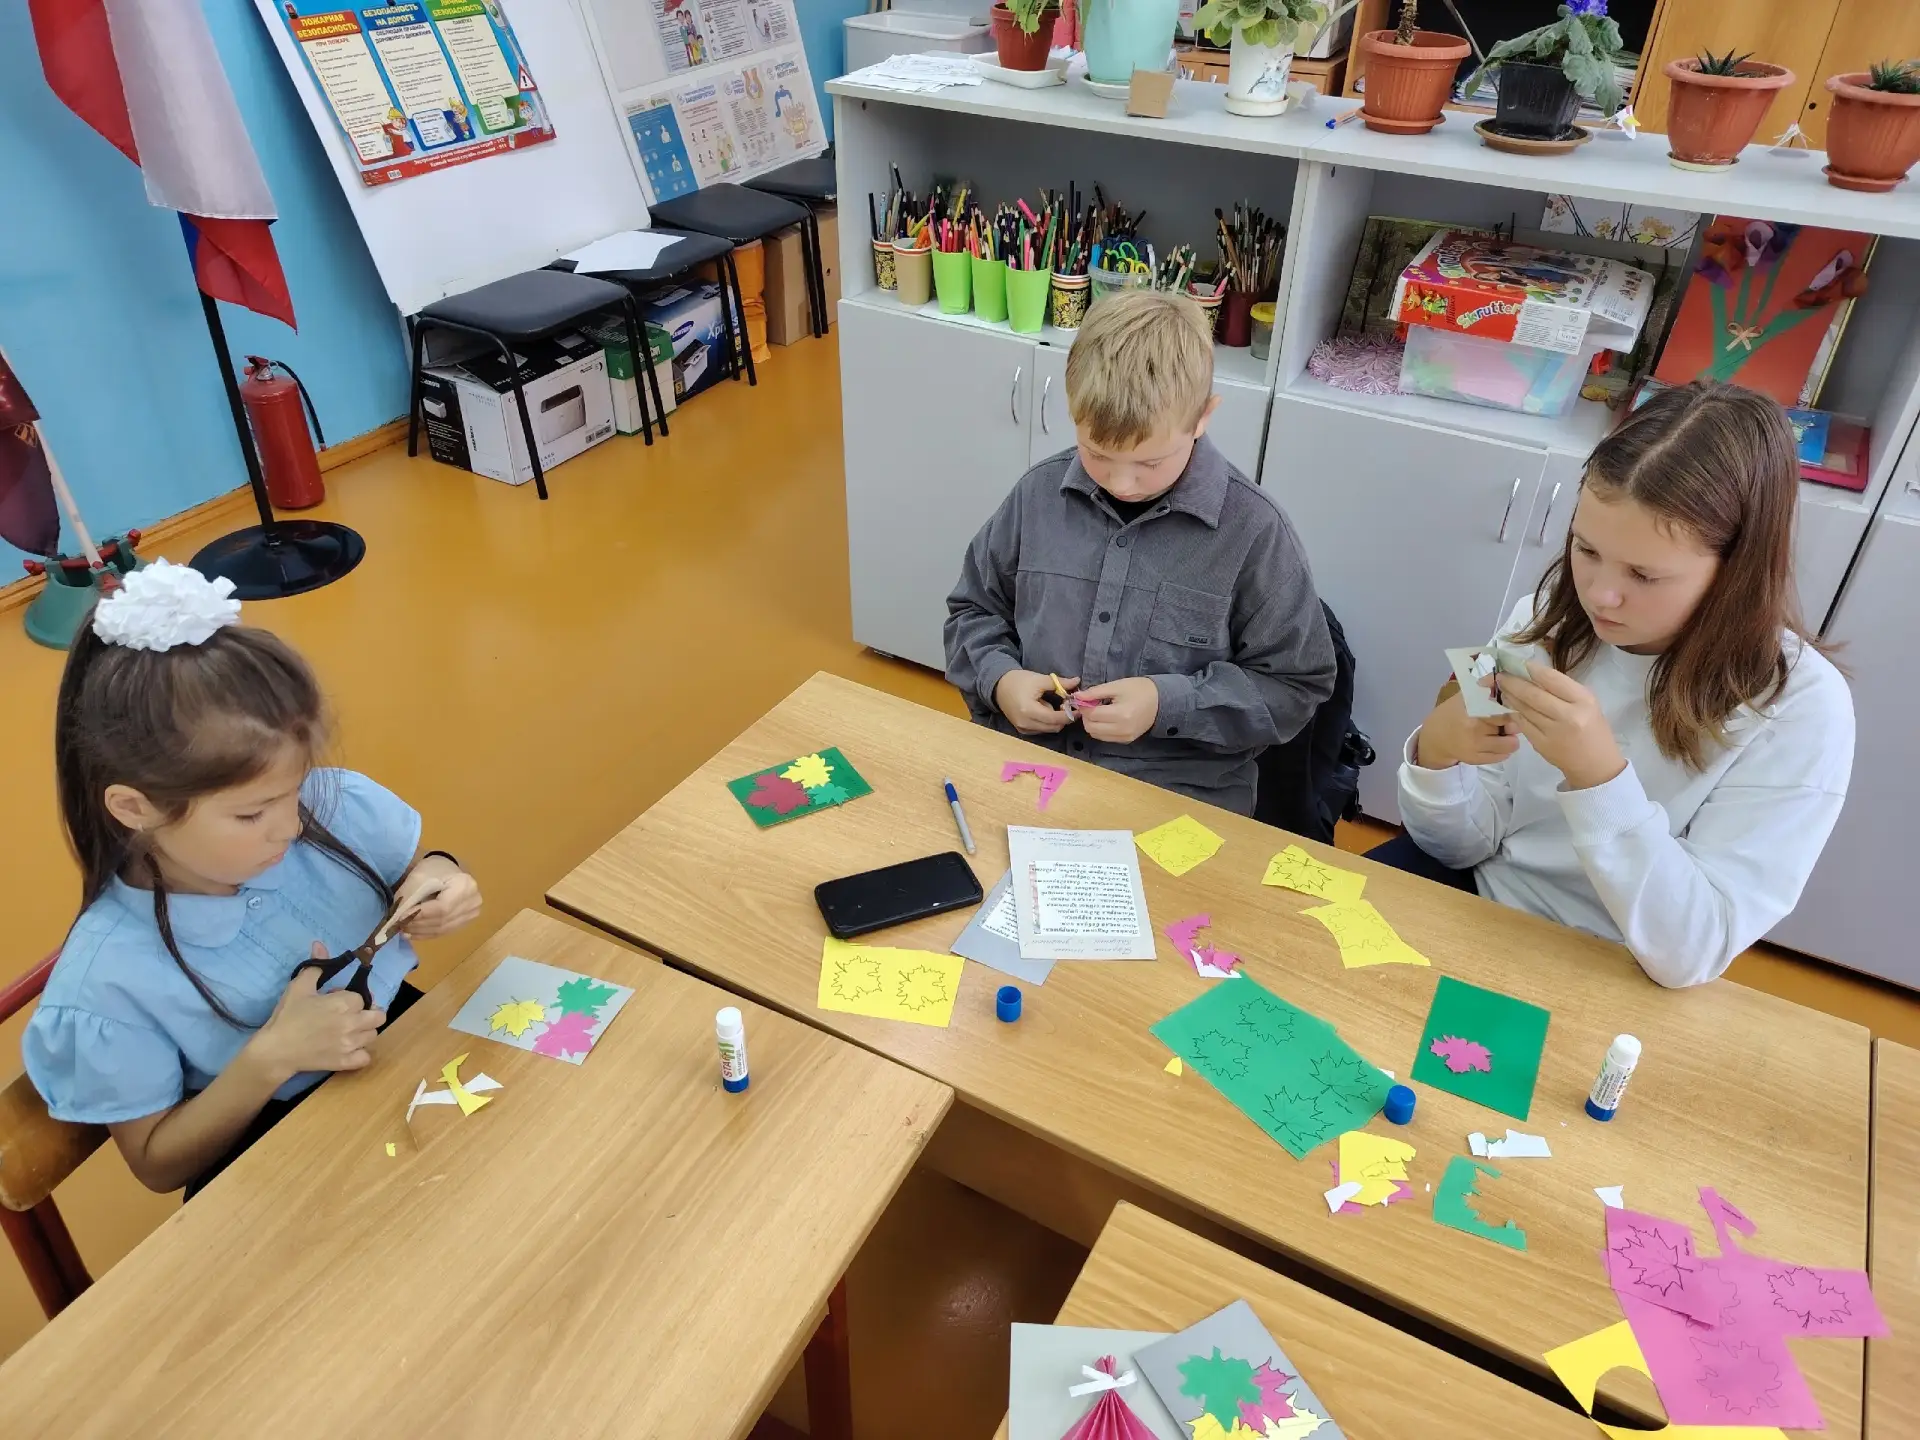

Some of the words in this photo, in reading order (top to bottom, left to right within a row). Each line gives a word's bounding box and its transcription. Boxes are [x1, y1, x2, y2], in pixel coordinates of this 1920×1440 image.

[362, 4, 418, 17] БЕЗОПАСНОСТЬ
[432, 5, 483, 17] БЕЗОПАСНОСТЬ
[301, 14, 345, 26] ПОЖАРНАЯ
[387, 14, 416, 25] ДОРОГЕ
[297, 23, 358, 38] БЕЗОПАСНОСТЬ
